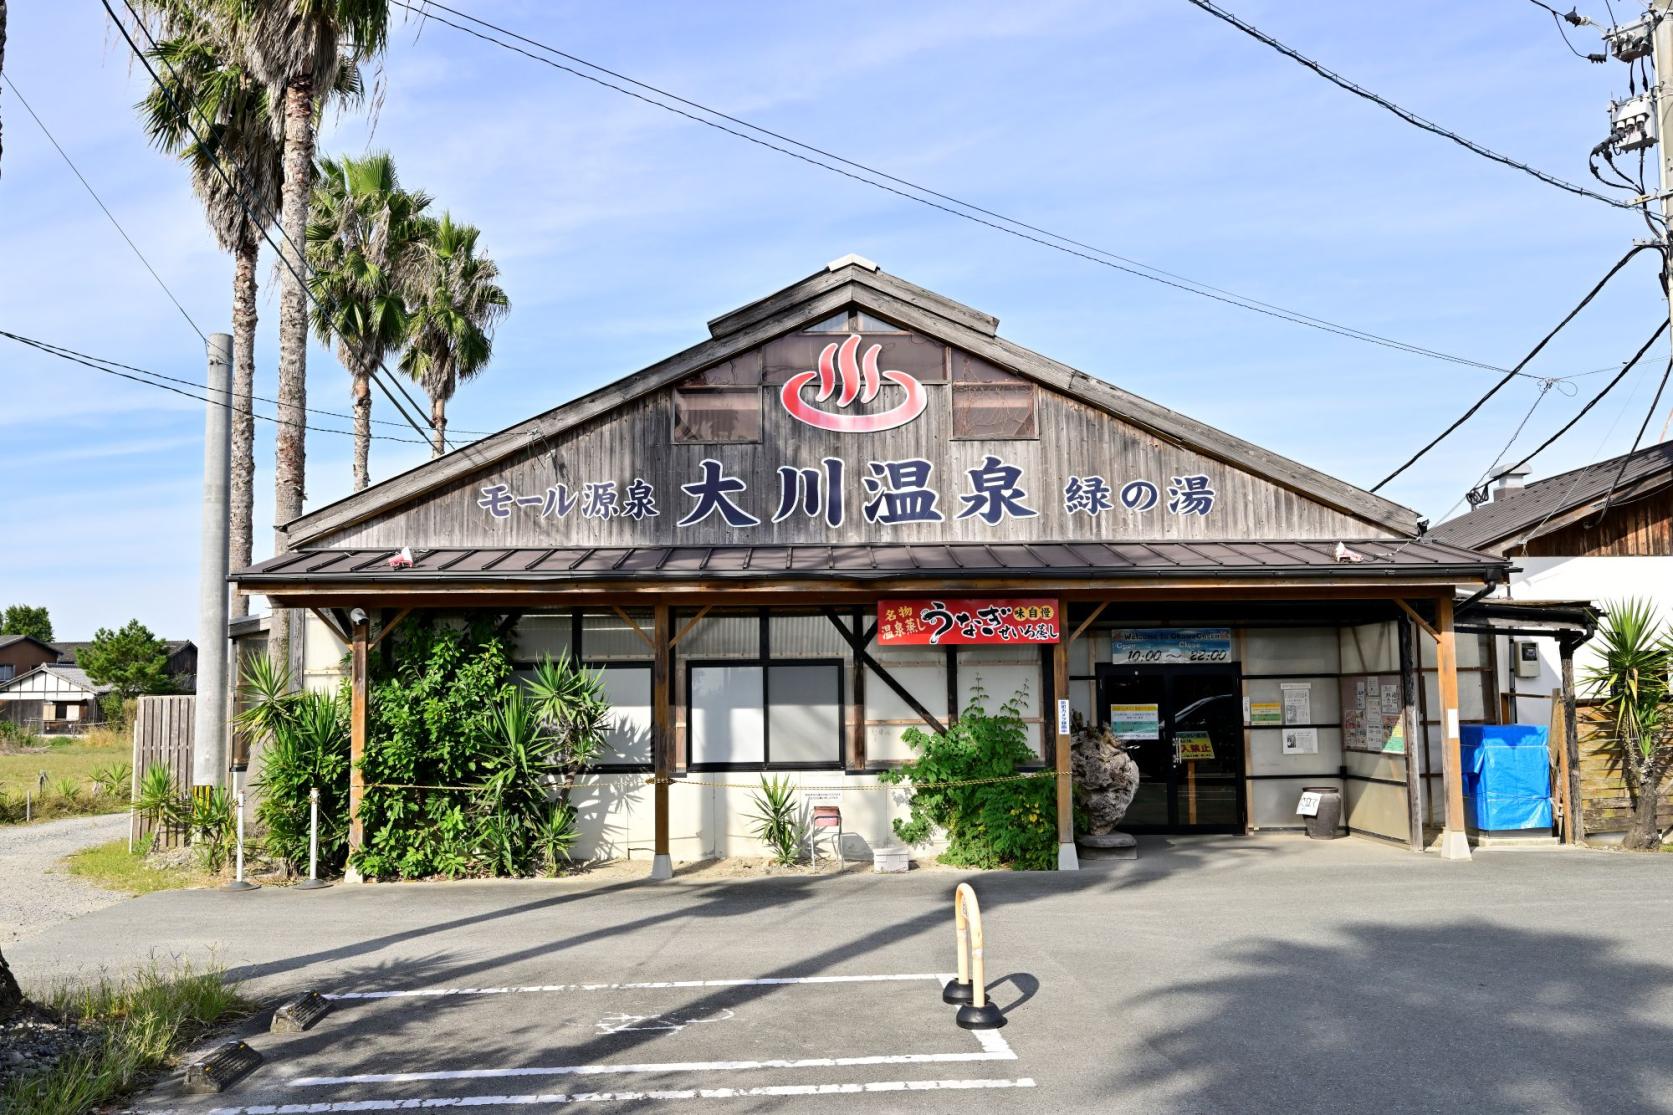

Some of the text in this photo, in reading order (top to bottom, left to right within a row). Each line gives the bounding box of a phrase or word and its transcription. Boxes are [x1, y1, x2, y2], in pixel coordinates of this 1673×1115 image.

[477, 455, 1216, 528] モール源泉 大川温泉 緑の湯
[885, 605, 913, 622] 名物
[1013, 605, 1054, 621] 味自慢
[881, 617, 927, 640] 温泉蒸し
[920, 600, 1012, 645] うなぎ
[998, 622, 1060, 640] せいろ蒸し
[1128, 650, 1162, 661] 10:00
[1190, 649, 1227, 661] 22:00
